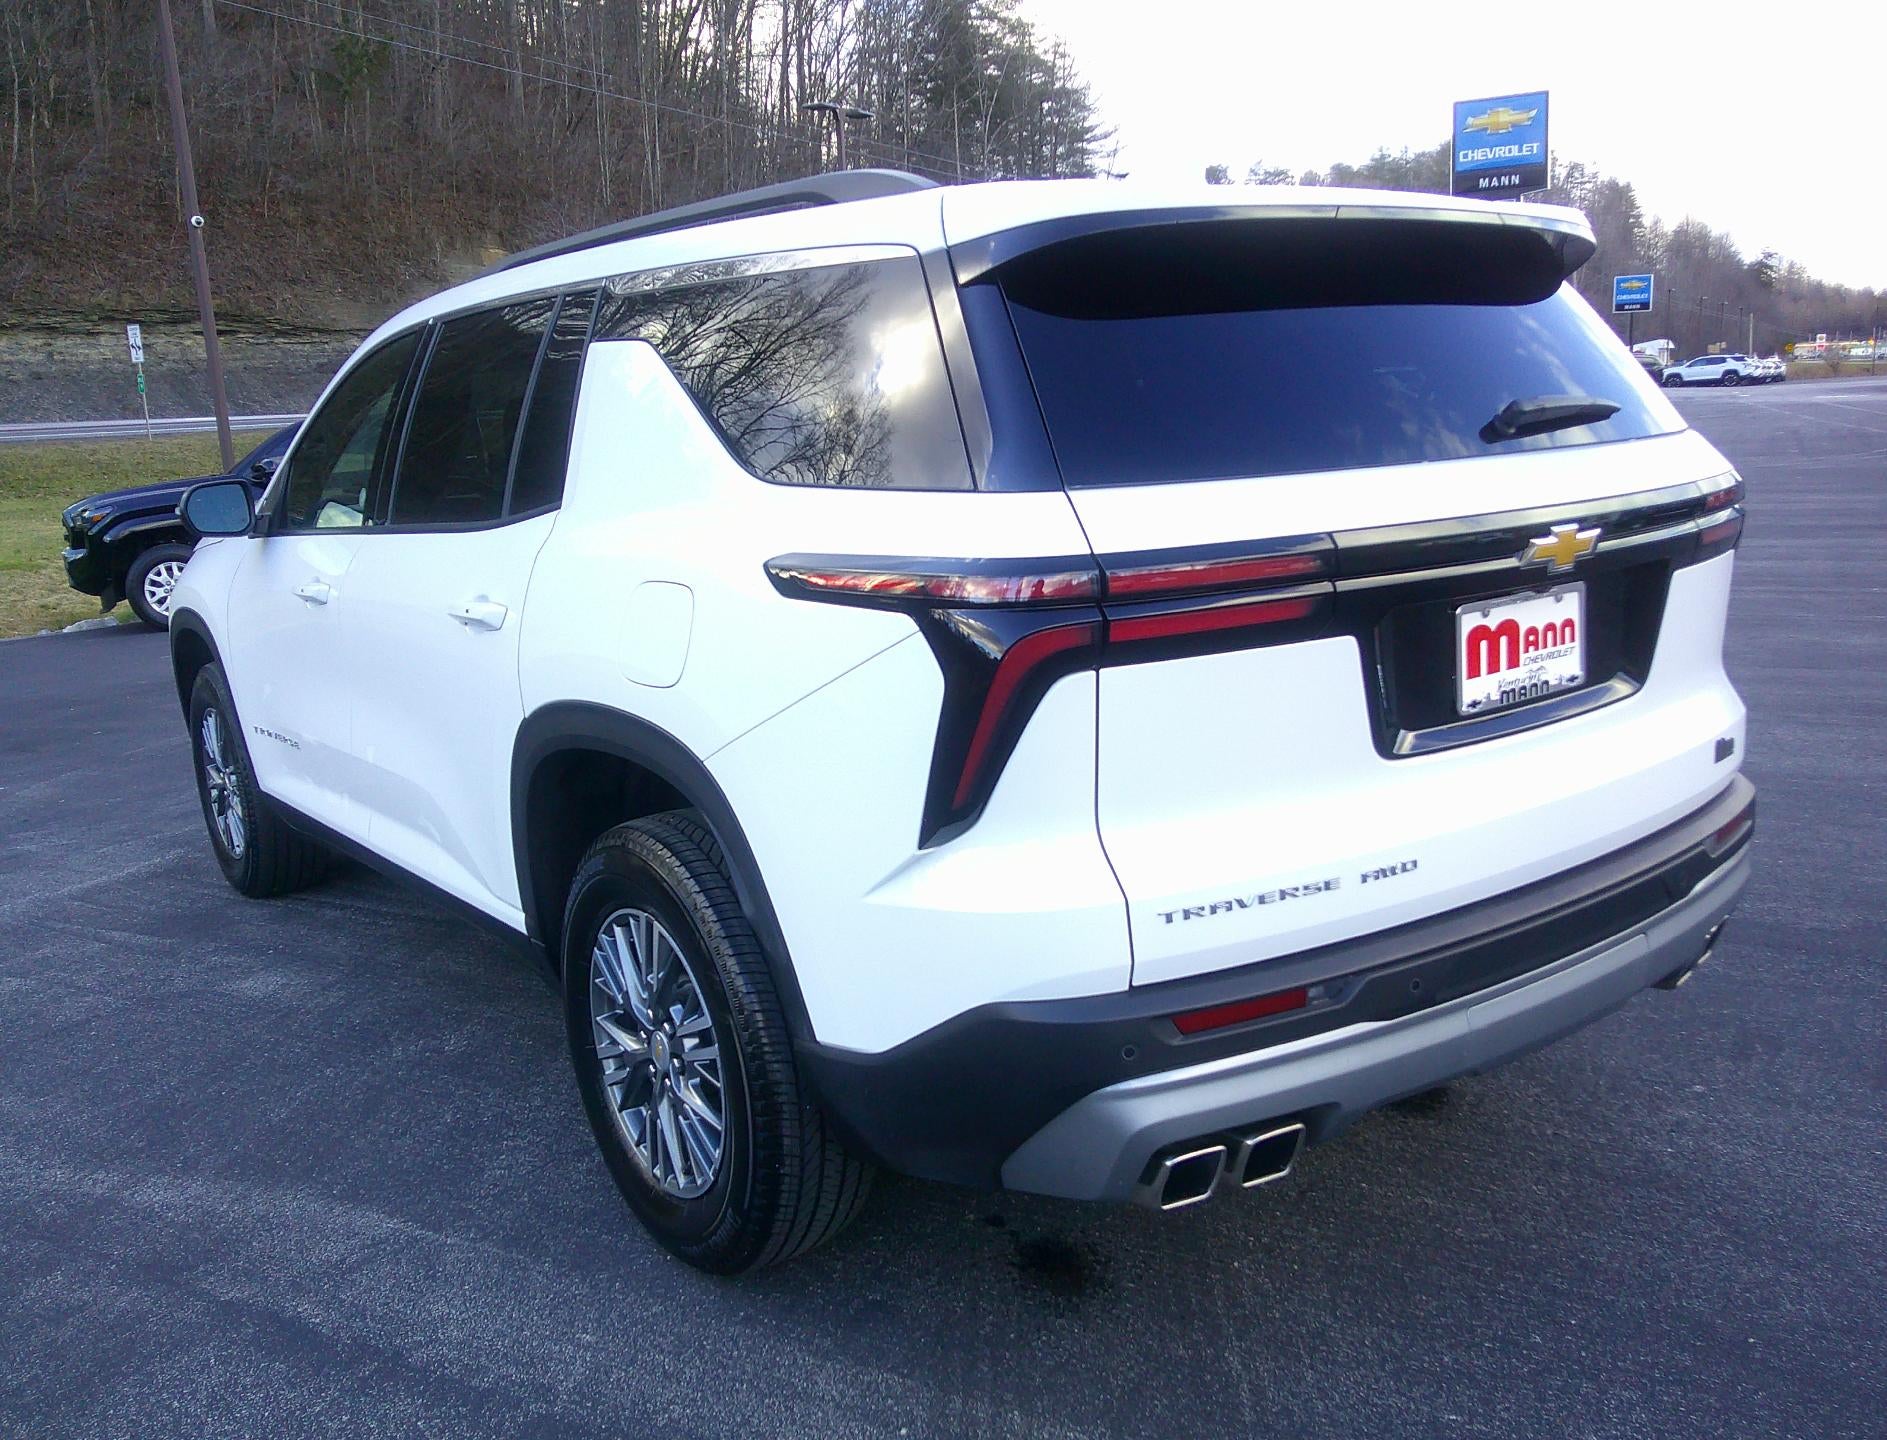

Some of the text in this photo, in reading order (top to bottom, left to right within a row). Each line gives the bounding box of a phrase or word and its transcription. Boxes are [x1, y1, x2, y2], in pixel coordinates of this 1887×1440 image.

[1459, 143, 1540, 162] CHEVROLET
[1479, 174, 1520, 189] MANN
[1522, 646, 1576, 666] CHEVROLET
[1157, 859, 1418, 924] TRAVERSE AWD
